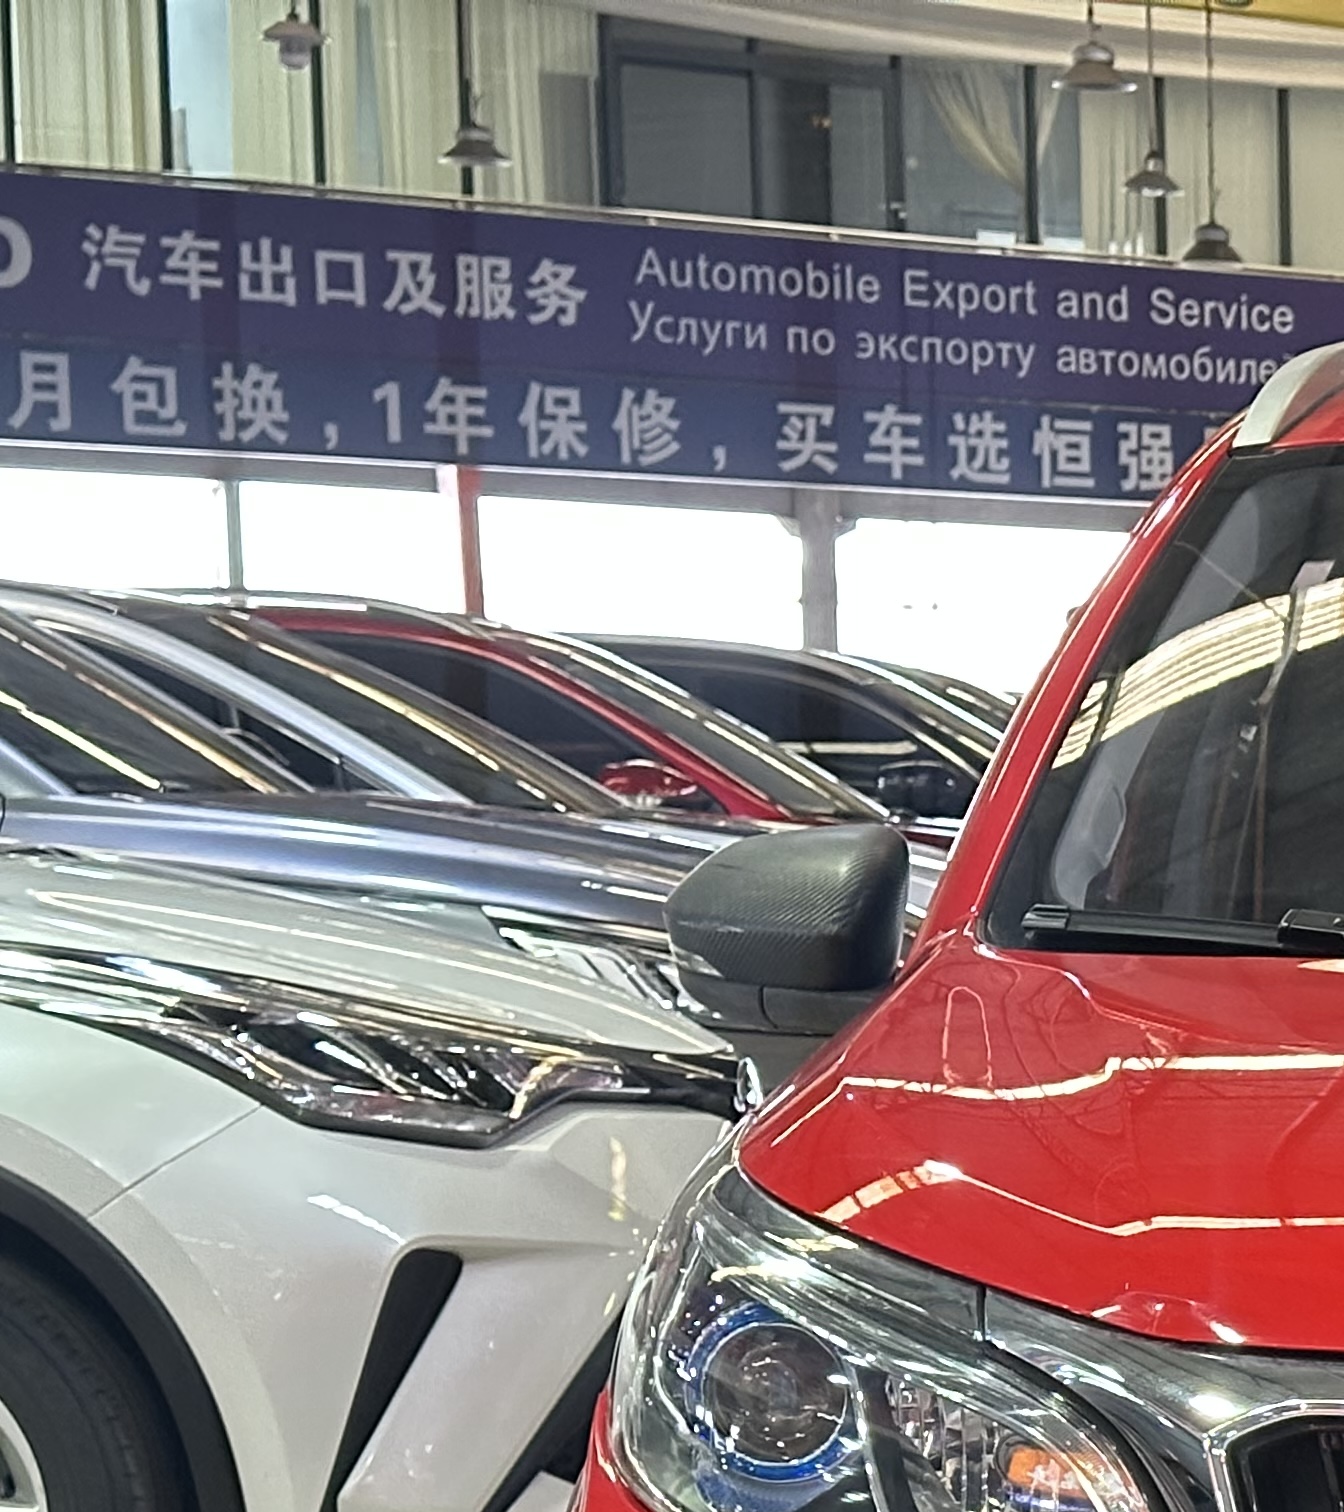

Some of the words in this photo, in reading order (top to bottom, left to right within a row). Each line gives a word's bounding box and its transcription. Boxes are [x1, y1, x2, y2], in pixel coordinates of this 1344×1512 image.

[80, 222, 588, 327] 汽车出口及服务
[635, 246, 882, 305] Automobile
[903, 268, 1038, 320] Export
[1056, 285, 1130, 323] and
[1149, 286, 1296, 334] Service
[627, 299, 769, 356] Услуги
[786, 325, 837, 356] по
[855, 330, 1036, 379] экспорту
[1055, 346, 1288, 387] автомобиле
